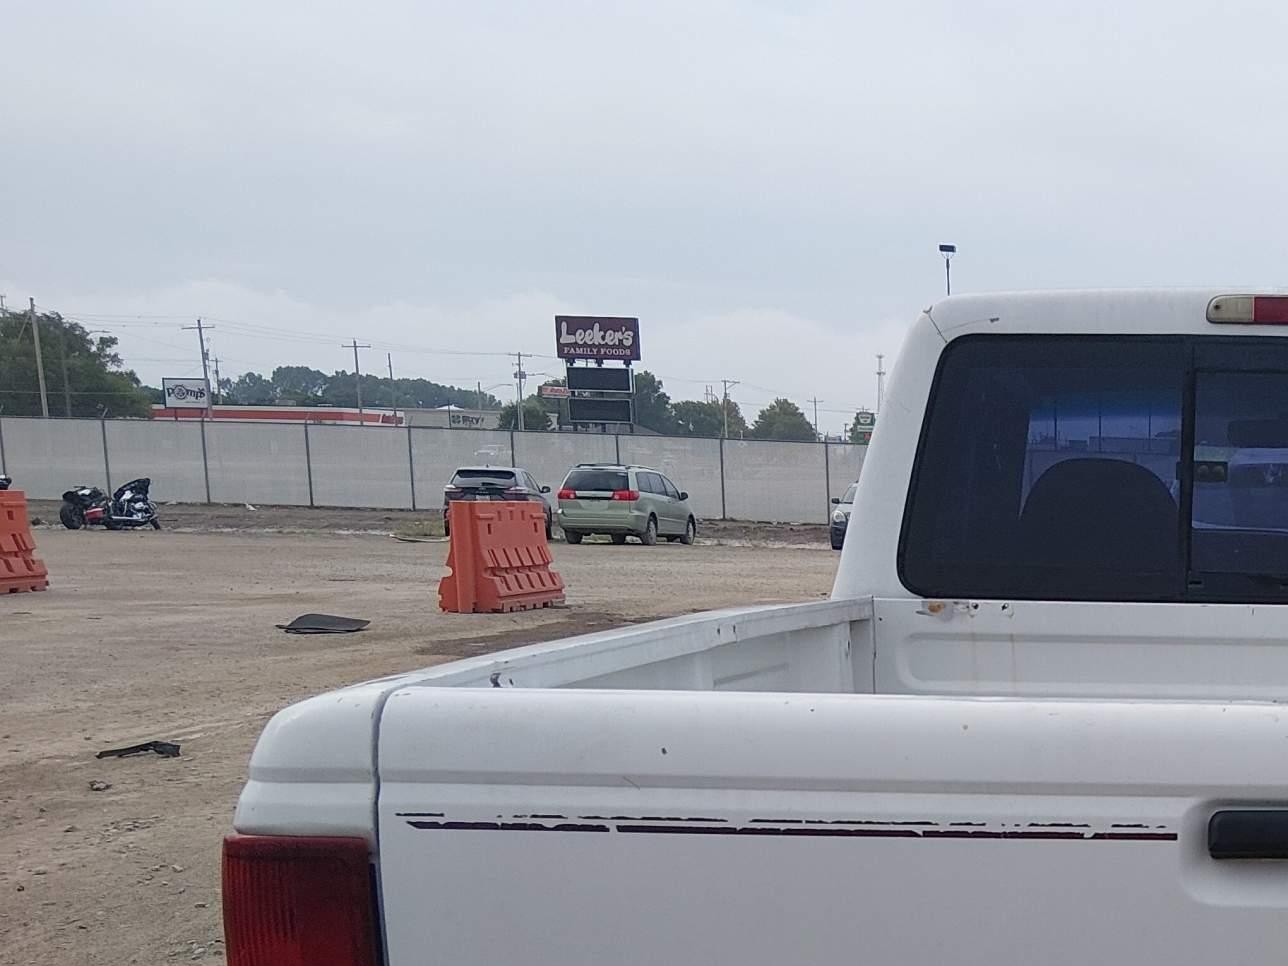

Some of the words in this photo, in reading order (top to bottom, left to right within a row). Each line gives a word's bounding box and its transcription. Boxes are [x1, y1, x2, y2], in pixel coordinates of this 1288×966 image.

[560, 321, 634, 346] Leeker's
[563, 346, 599, 355] FAMILY
[600, 348, 632, 356] FOODS
